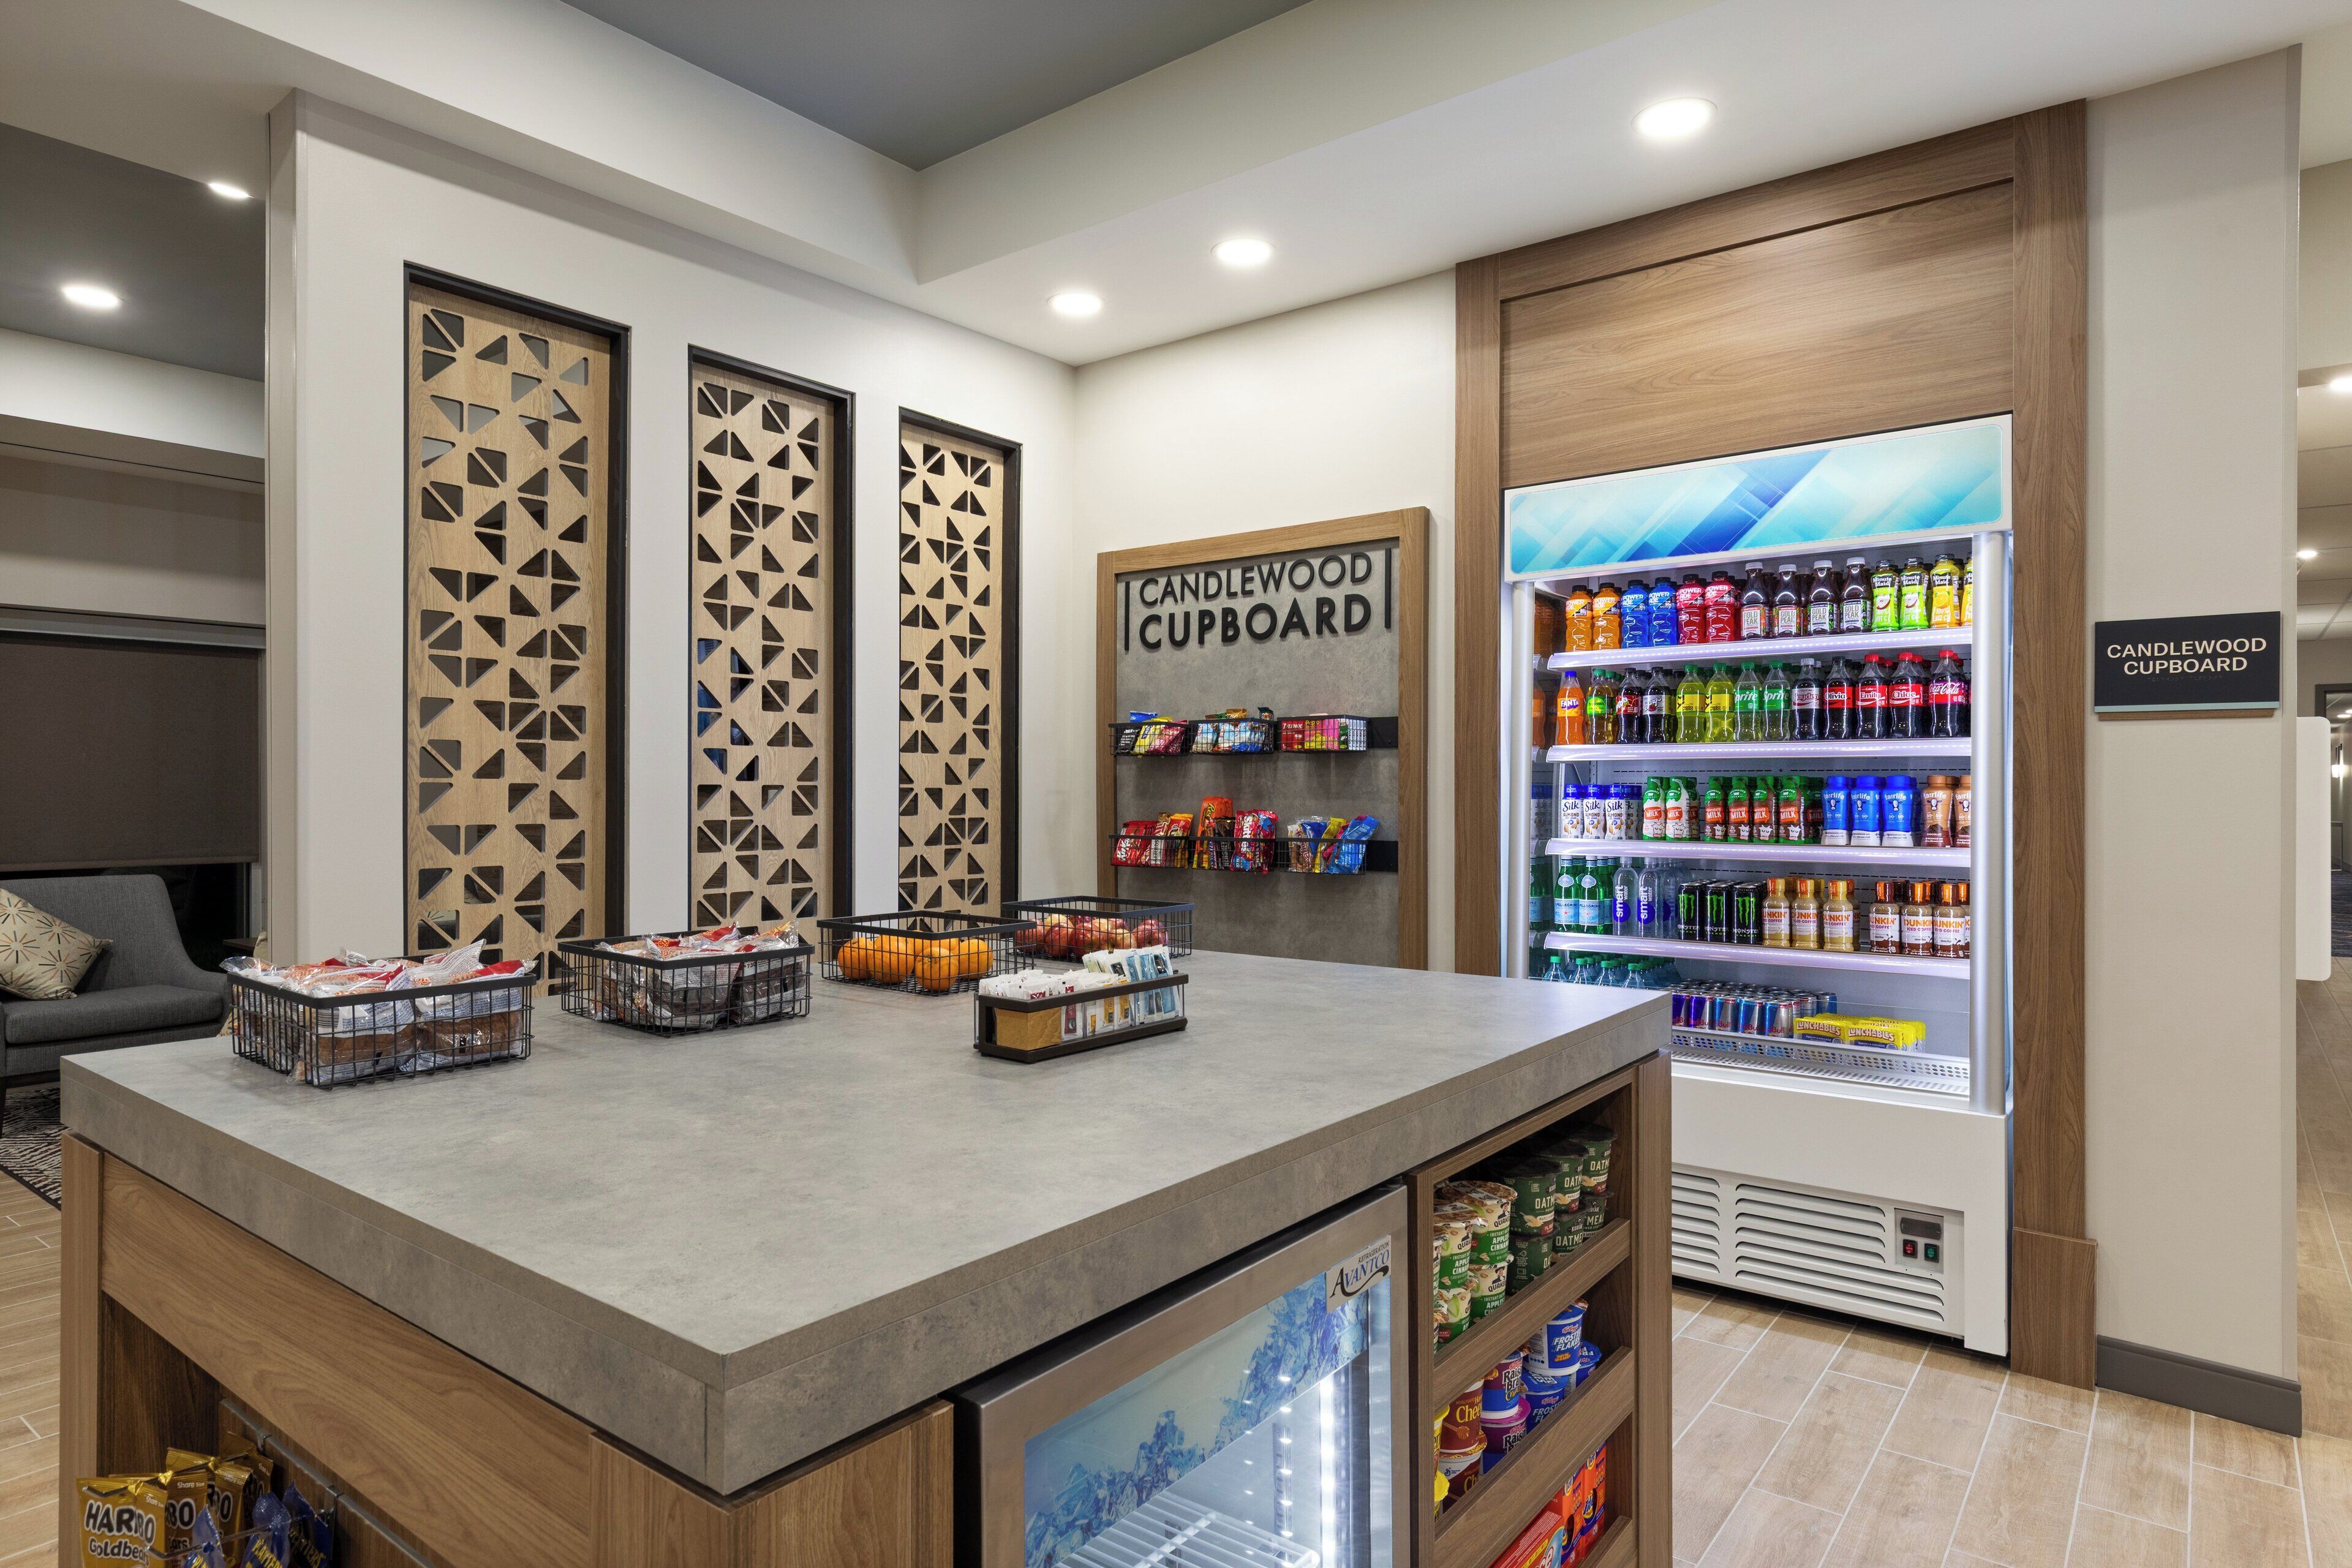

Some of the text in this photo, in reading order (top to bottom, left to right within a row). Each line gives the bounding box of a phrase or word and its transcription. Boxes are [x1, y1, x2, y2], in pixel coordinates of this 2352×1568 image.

[1139, 552, 1371, 606] CANDLEWOOD
[1139, 594, 1371, 649] CUPBOARD
[2107, 638, 2267, 658] CANDLEWOOD
[2124, 657, 2247, 675] CUPBOARD
[1763, 690, 1789, 702] Sprite
[1563, 801, 1580, 812] Silk
[1585, 801, 1600, 812] Silk
[1607, 801, 1623, 812] Silk
[1781, 810, 1796, 820] MILK
[1796, 1021, 1841, 1036] LUNCHABLES
[1848, 1028, 1894, 1041] LUNCHABLES
[1590, 1158, 1610, 1170] OATM
[1536, 1196, 1555, 1209] OATM
[1358, 1240, 1390, 1264] REFRIGERATION
[1329, 1249, 1390, 1298] AVANTCO
[1506, 1377, 1521, 1392] Bra
[1456, 1404, 1482, 1423] Chee
[146, 1494, 158, 1506] Share
[85, 1500, 156, 1545] HARIBO
[89, 1537, 149, 1566] Goldbears
